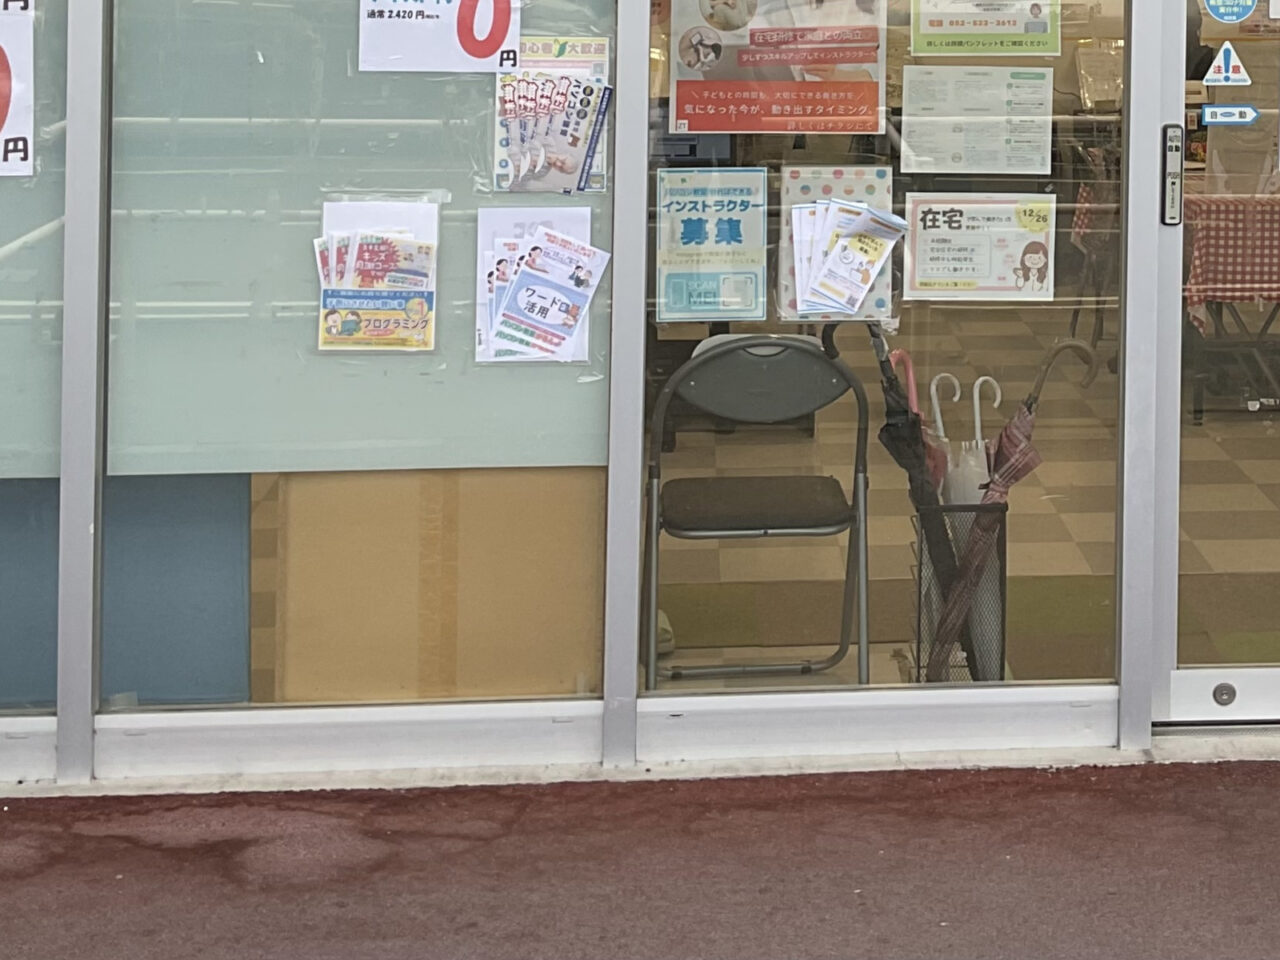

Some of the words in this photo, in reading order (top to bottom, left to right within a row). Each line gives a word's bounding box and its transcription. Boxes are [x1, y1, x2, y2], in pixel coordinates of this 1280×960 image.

[662, 200, 764, 213] インストラクター
[920, 208, 963, 230] 在宅
[680, 217, 743, 245] 募集
[524, 300, 550, 319] 活用
[364, 319, 429, 330] プログラミング
